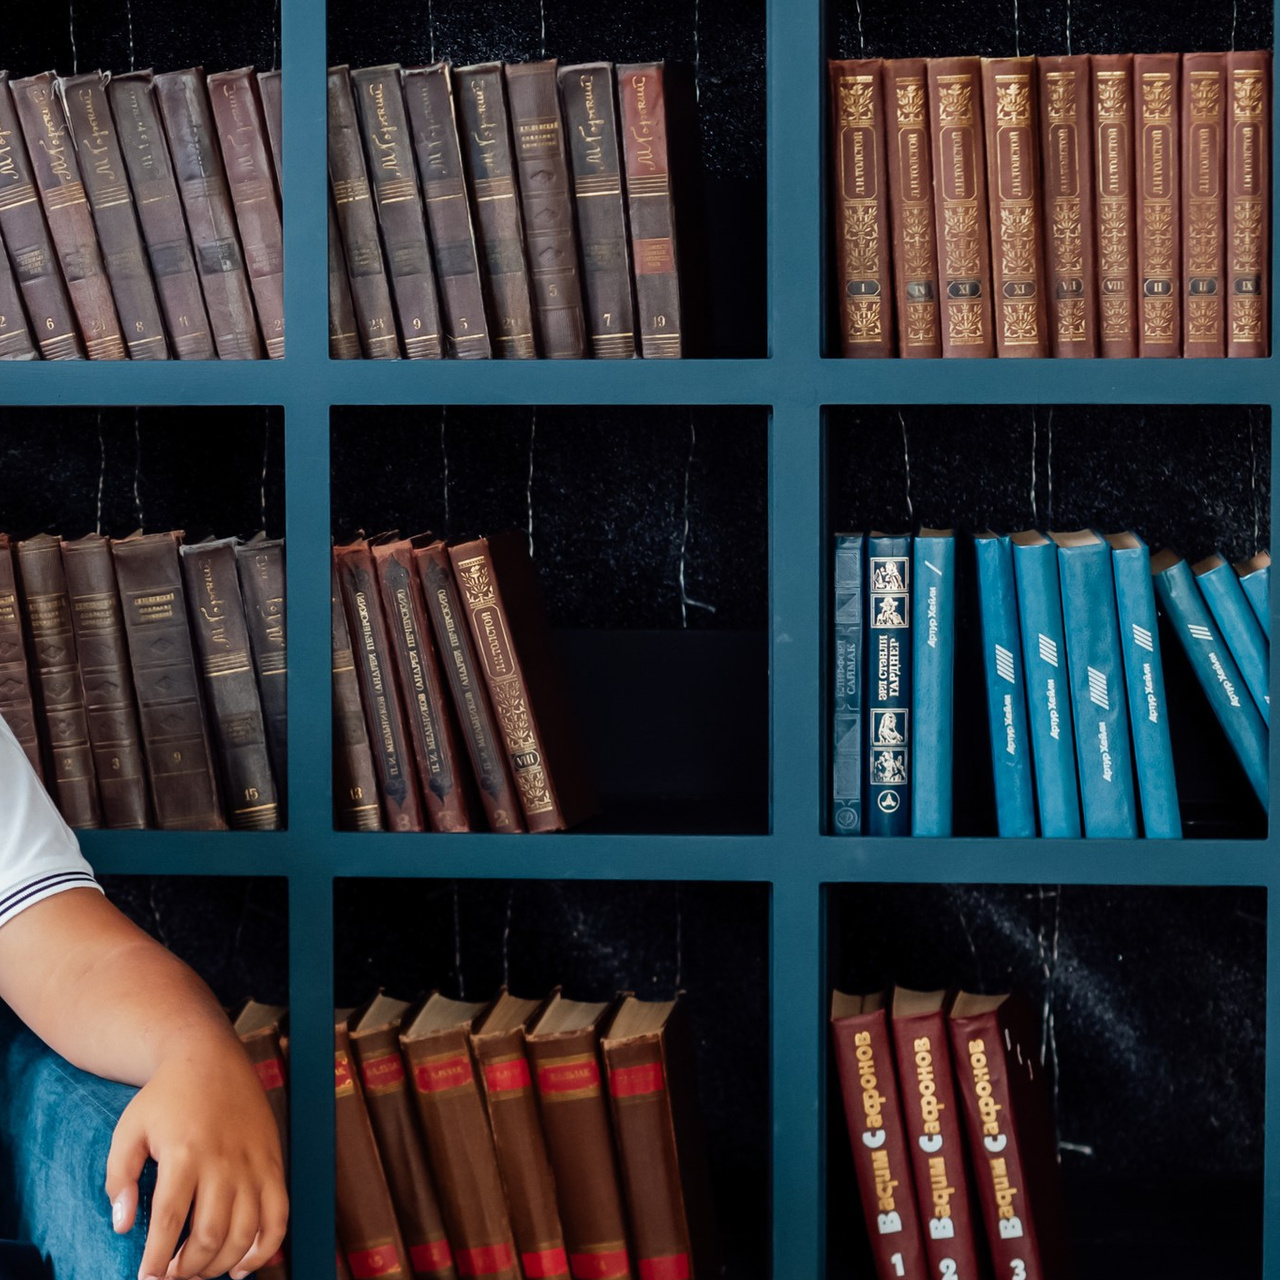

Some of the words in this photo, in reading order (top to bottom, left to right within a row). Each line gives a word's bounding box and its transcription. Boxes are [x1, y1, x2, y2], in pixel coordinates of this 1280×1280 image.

[46, 318, 55, 331] 6
[135, 321, 145, 333] 8
[413, 318, 421, 330] 9
[603, 314, 612, 327] 7
[928, 587, 936, 618] Хейли
[928, 619, 937, 648] Артур
[846, 643, 856, 695] САЙМАК
[889, 638, 901, 697] ГАРДНЕР
[1143, 663, 1153, 693] Хейли
[1209, 653, 1227, 682] Хейли
[1047, 679, 1056, 710] Хейли
[1223, 681, 1240, 706] Артур
[1003, 695, 1012, 725] Хейли
[1148, 694, 1157, 723] Артур
[1050, 710, 1060, 739] Артур
[1098, 722, 1108, 752] Хейли
[1006, 726, 1015, 755] Артур
[1102, 753, 1112, 782] Артур
[244, 788, 259, 801] 15
[854, 1031, 886, 1150] Сафонов
[913, 1036, 946, 1154] Сафонов
[967, 1038, 1008, 1154] Сафонов
[871, 1149, 903, 1235] Вадим
[928, 1155, 956, 1240] Вадим
[989, 1157, 1024, 1240] Вадим
[890, 1252, 905, 1277] 1
